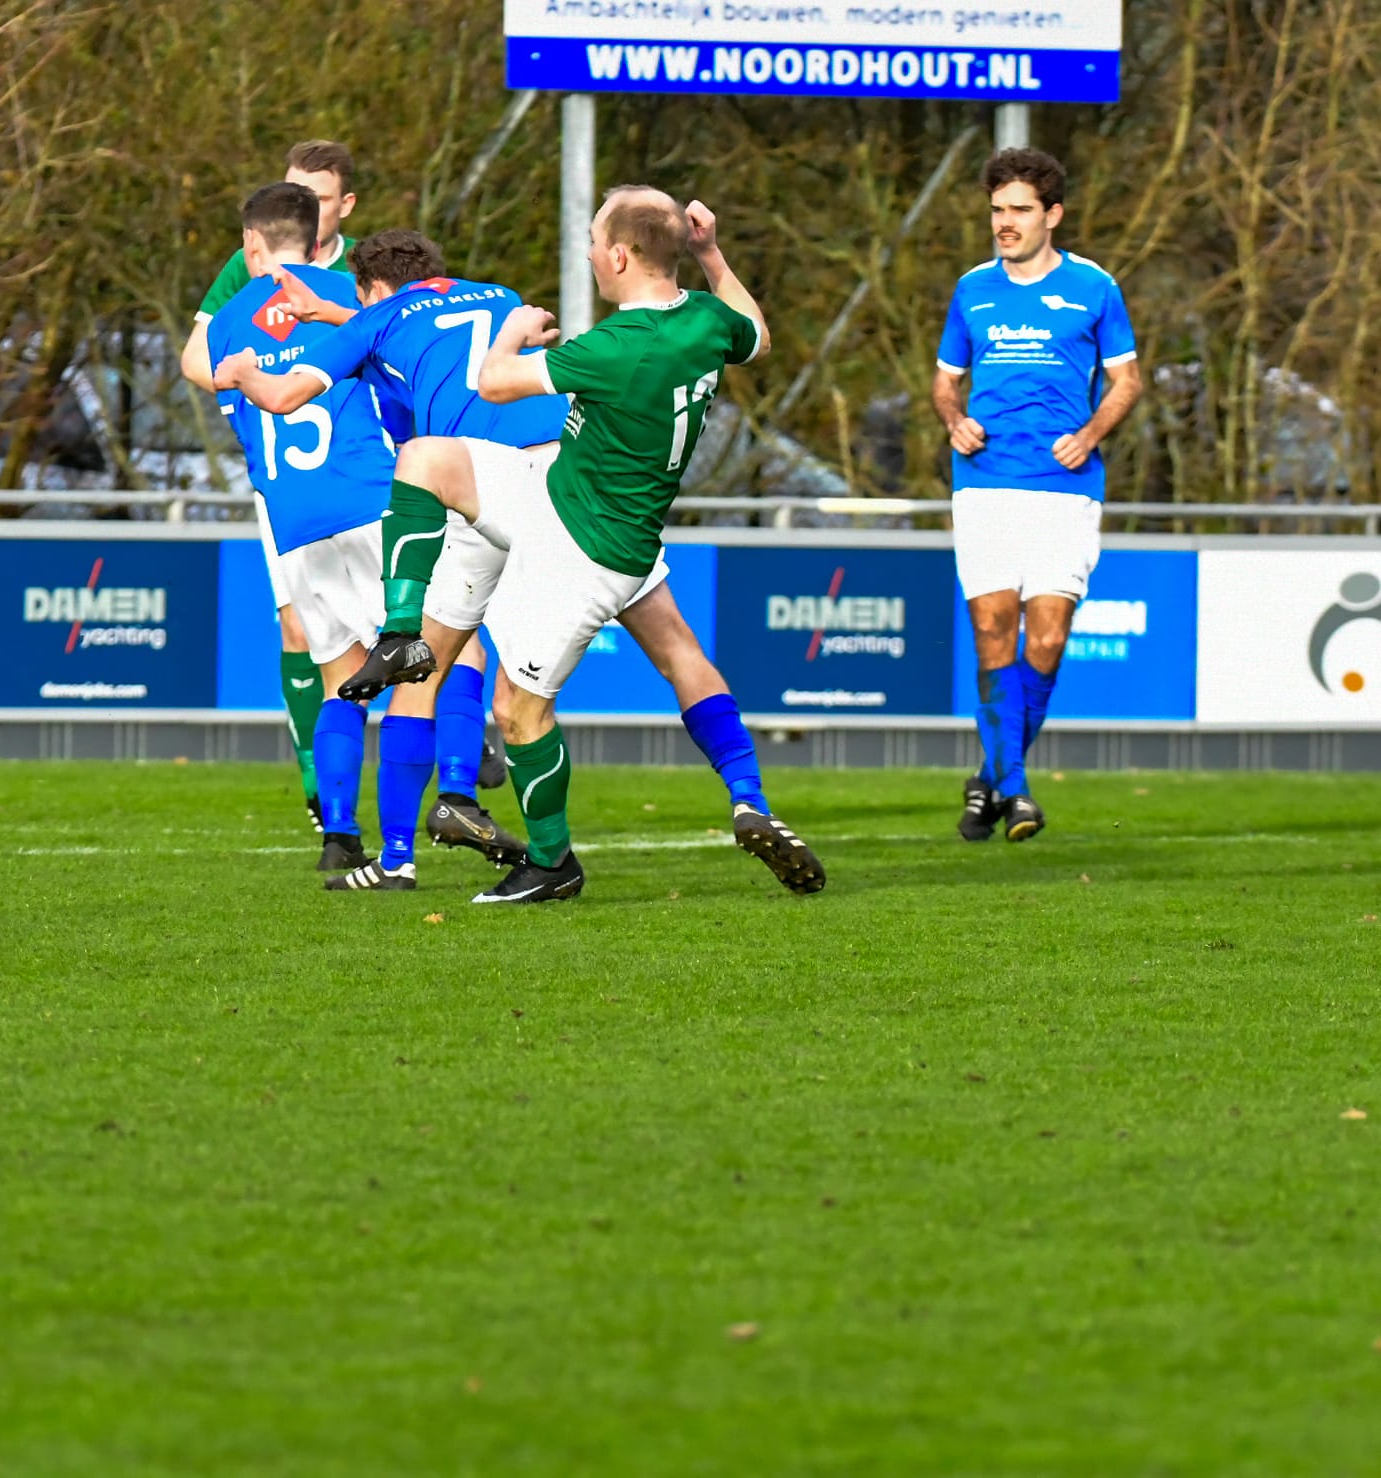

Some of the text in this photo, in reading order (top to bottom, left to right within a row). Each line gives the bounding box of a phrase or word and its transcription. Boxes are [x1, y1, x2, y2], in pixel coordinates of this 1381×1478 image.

[846, 6, 943, 26] modern
[586, 44, 1041, 89] WWW.NOORDHOUT.NL
[401, 288, 506, 319] AUTO MELSE
[257, 353, 275, 369] TO
[434, 309, 492, 390] 7
[246, 398, 333, 481] 15
[24, 587, 166, 622] DAMEN
[768, 595, 905, 631] DAMEN
[80, 626, 166, 650] yachting
[821, 635, 905, 658] yachting
